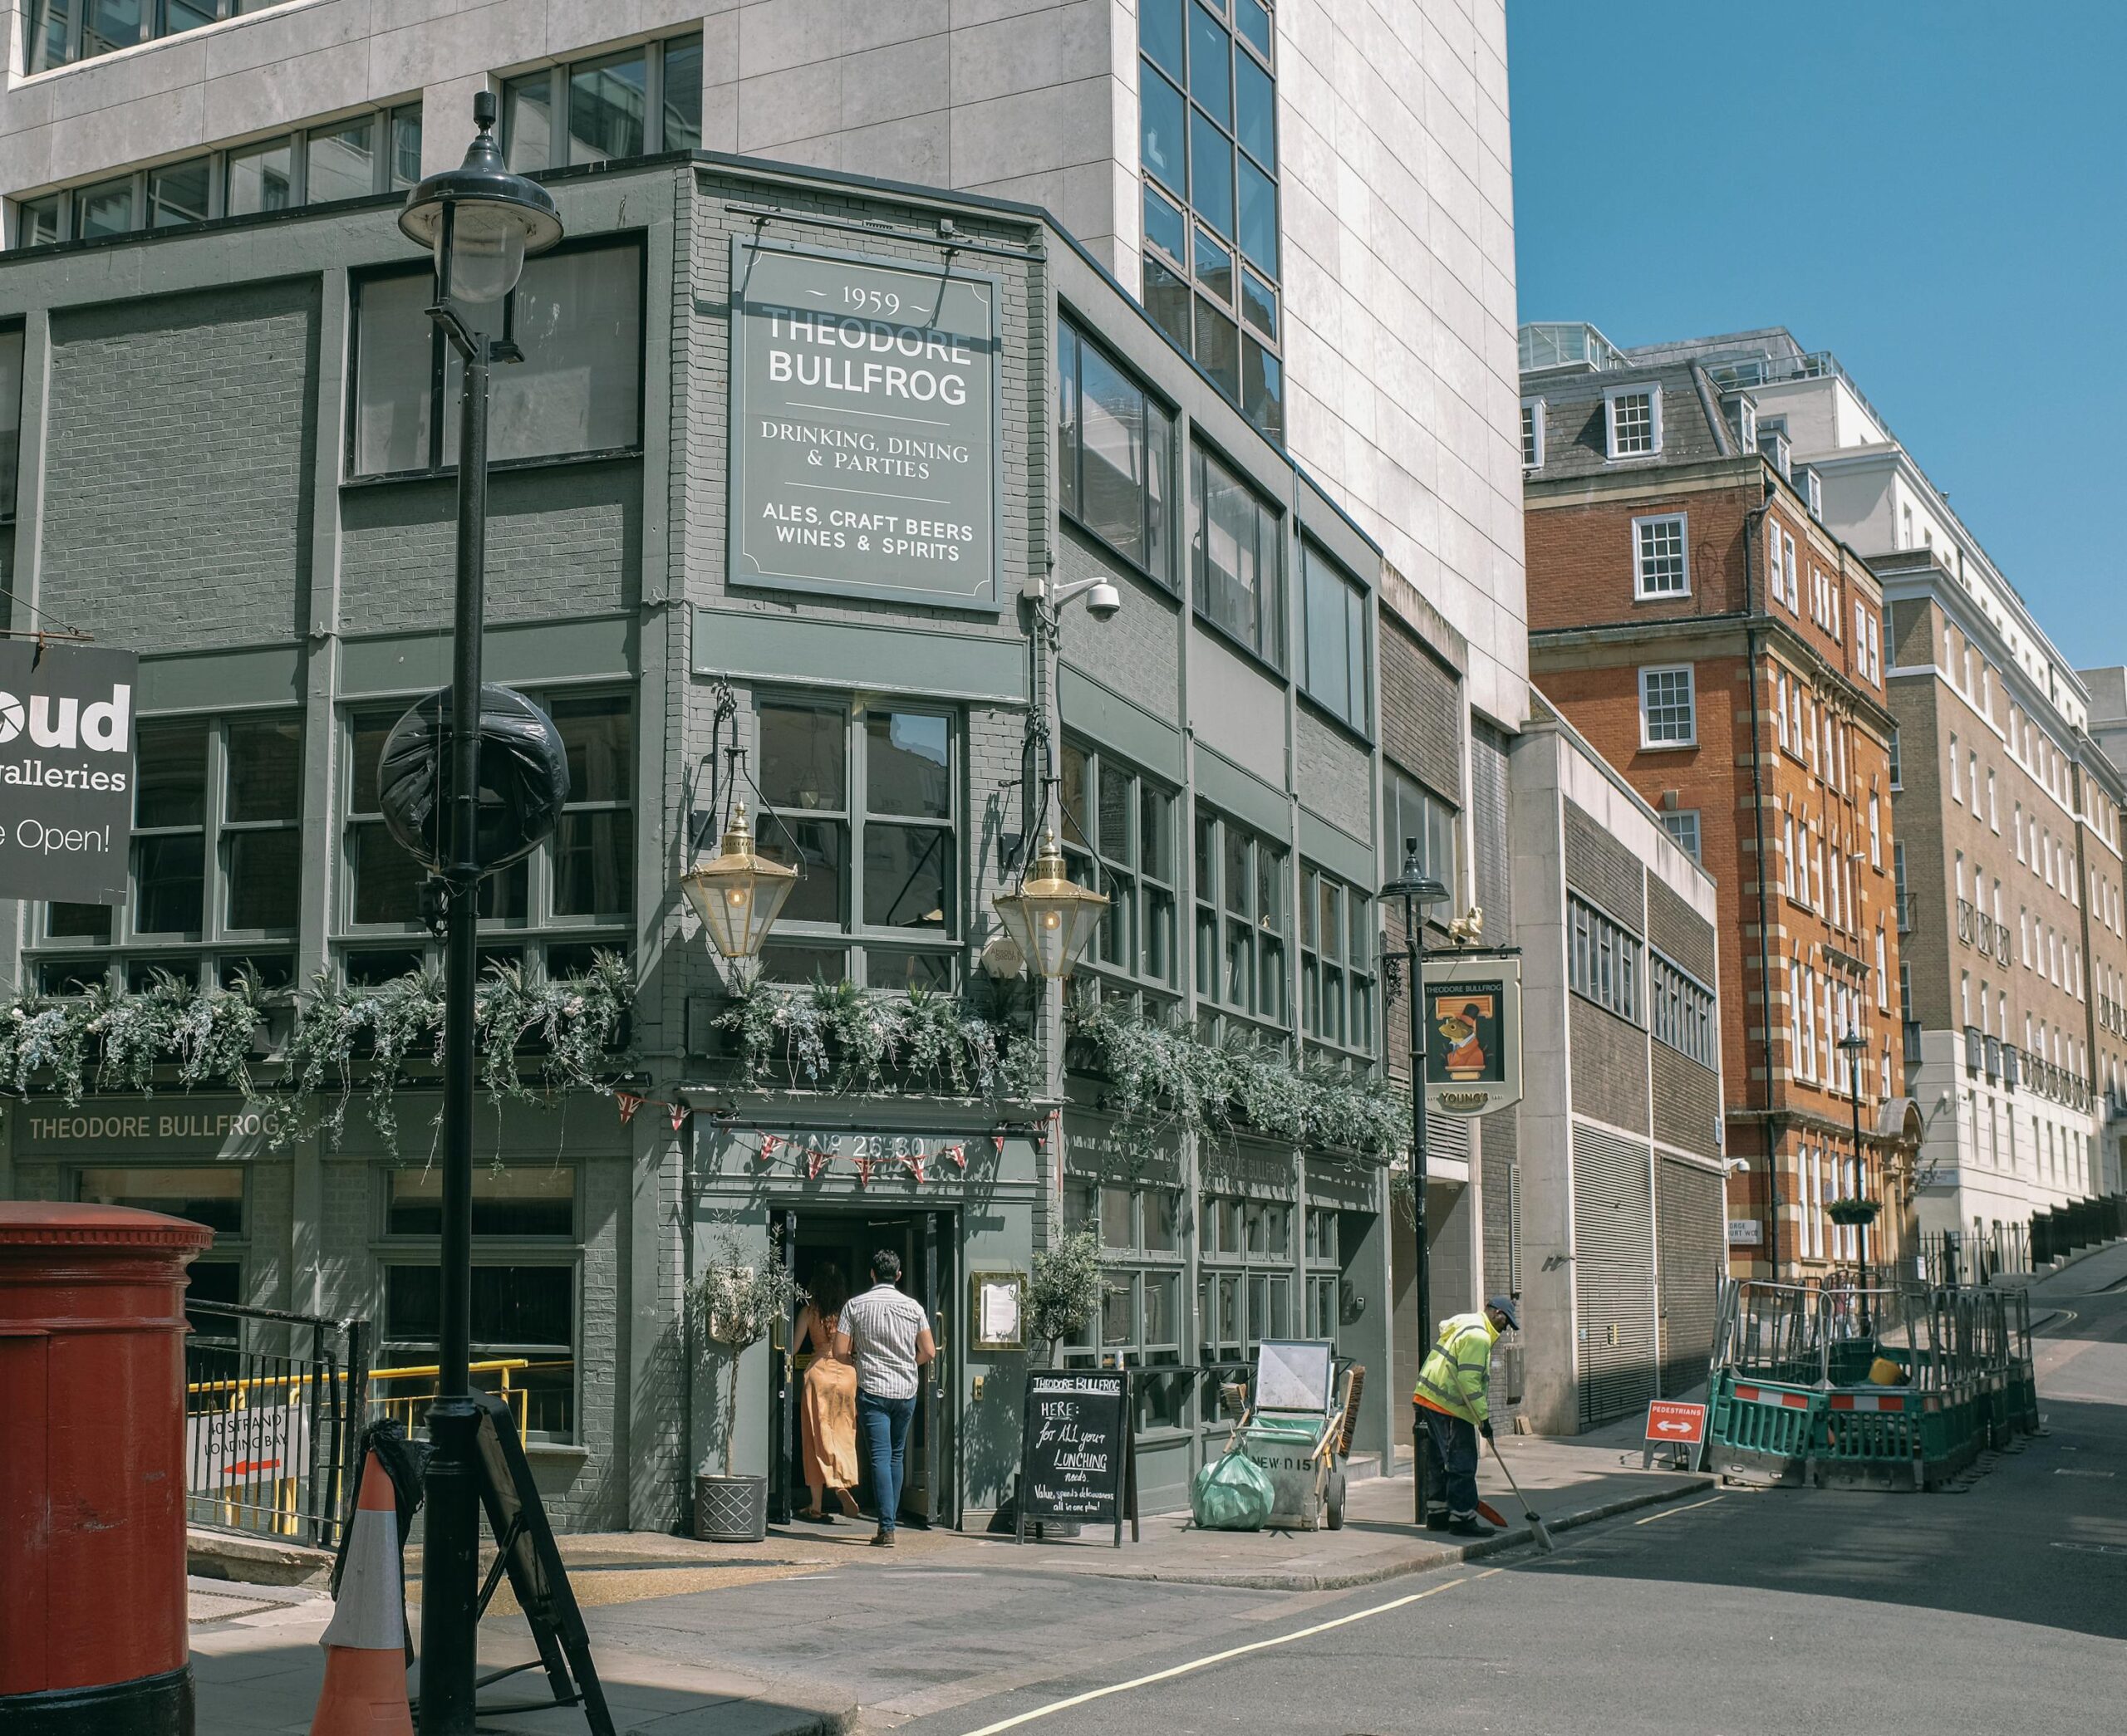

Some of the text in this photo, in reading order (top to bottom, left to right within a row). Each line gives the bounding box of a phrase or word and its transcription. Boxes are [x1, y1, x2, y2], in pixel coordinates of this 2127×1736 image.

[843, 285, 900, 316] 1959
[762, 306, 971, 365] THEODORE
[769, 350, 966, 405] BULLFROG
[761, 421, 969, 463] DRINKING, DINING
[808, 449, 930, 479] & PARTIES
[763, 503, 974, 542] ALES, CRAFT BEERS
[775, 526, 960, 562] WINES & SPIRITS
[0, 759, 126, 792] alleries
[17, 819, 110, 856] Open!
[1427, 984, 1501, 993] THEODORE BULLFROG
[30, 1114, 280, 1139] THEODORE BULLFROG
[1034, 1376, 1120, 1392] THEODORE BULLFROG
[1041, 1401, 1079, 1417] HERE:
[1652, 1405, 1702, 1416] PEDESTRIANS
[1036, 1421, 1056, 1449] for
[1078, 1432, 1105, 1452] your
[1054, 1449, 1108, 1469] LUNCHING
